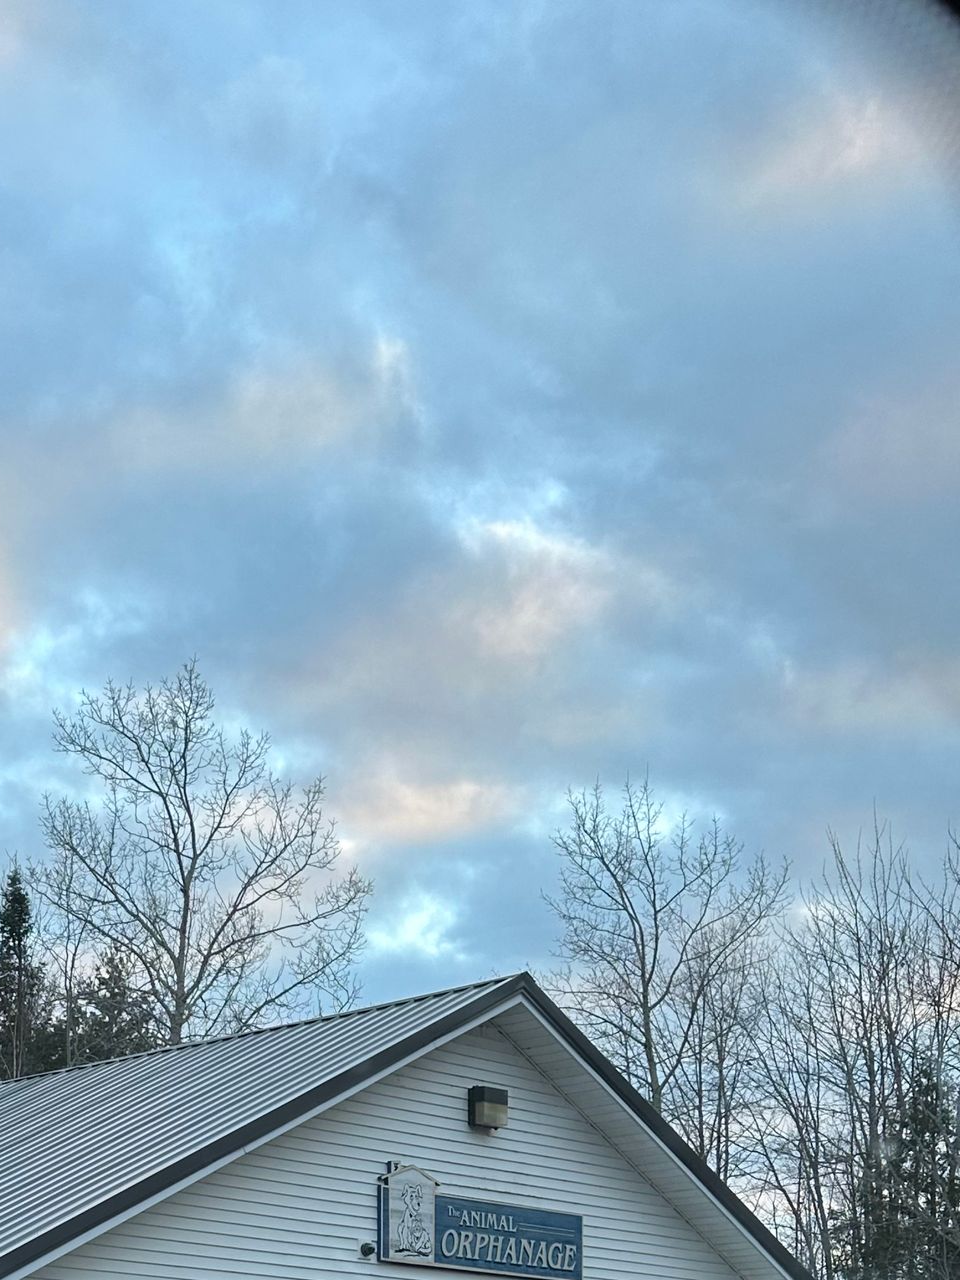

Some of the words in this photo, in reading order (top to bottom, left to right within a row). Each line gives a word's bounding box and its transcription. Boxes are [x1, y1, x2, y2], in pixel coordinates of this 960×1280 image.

[447, 1205, 460, 1218] The
[459, 1209, 518, 1233] ANIMAL
[441, 1228, 577, 1271] ORPHANAGE
